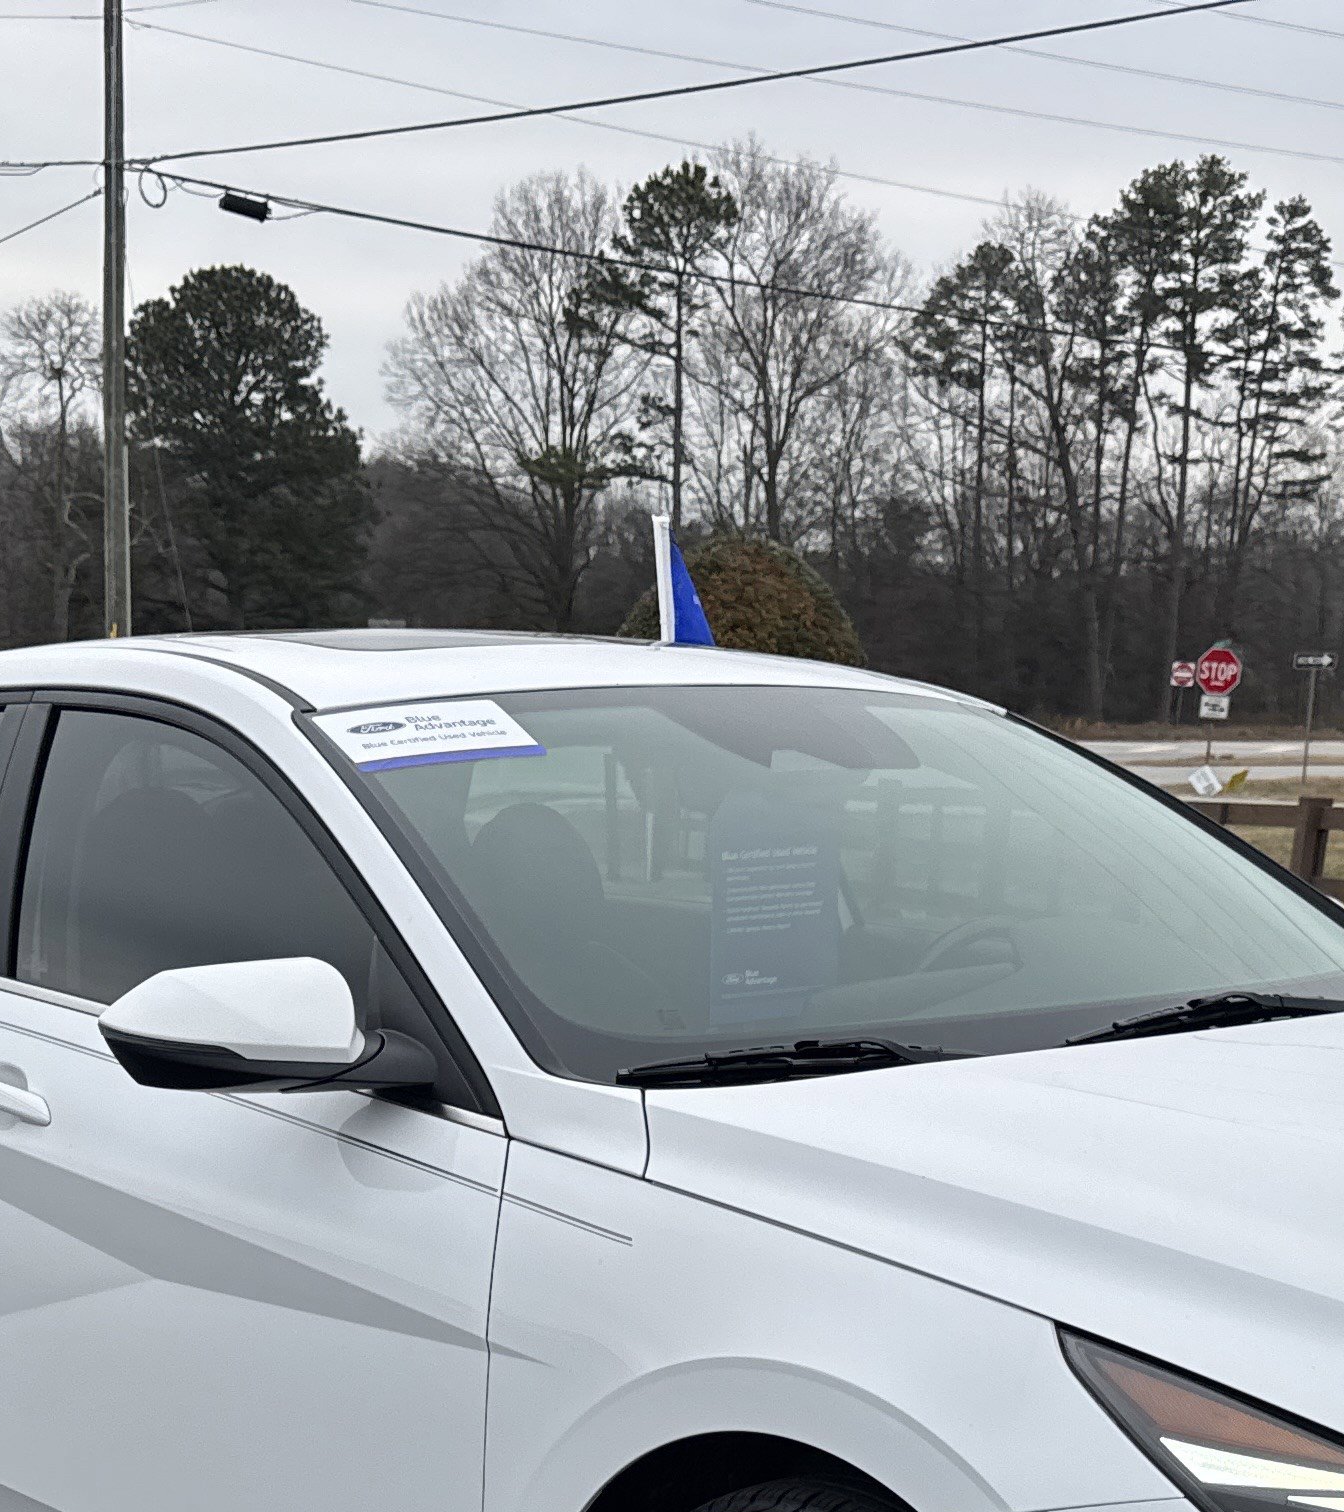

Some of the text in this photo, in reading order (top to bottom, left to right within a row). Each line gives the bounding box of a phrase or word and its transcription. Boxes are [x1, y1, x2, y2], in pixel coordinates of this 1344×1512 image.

[1200, 661, 1237, 682] STOP
[405, 715, 442, 724] Blue
[414, 718, 497, 731] Advantage
[360, 723, 394, 733] Ford
[390, 735, 436, 745] Certified
